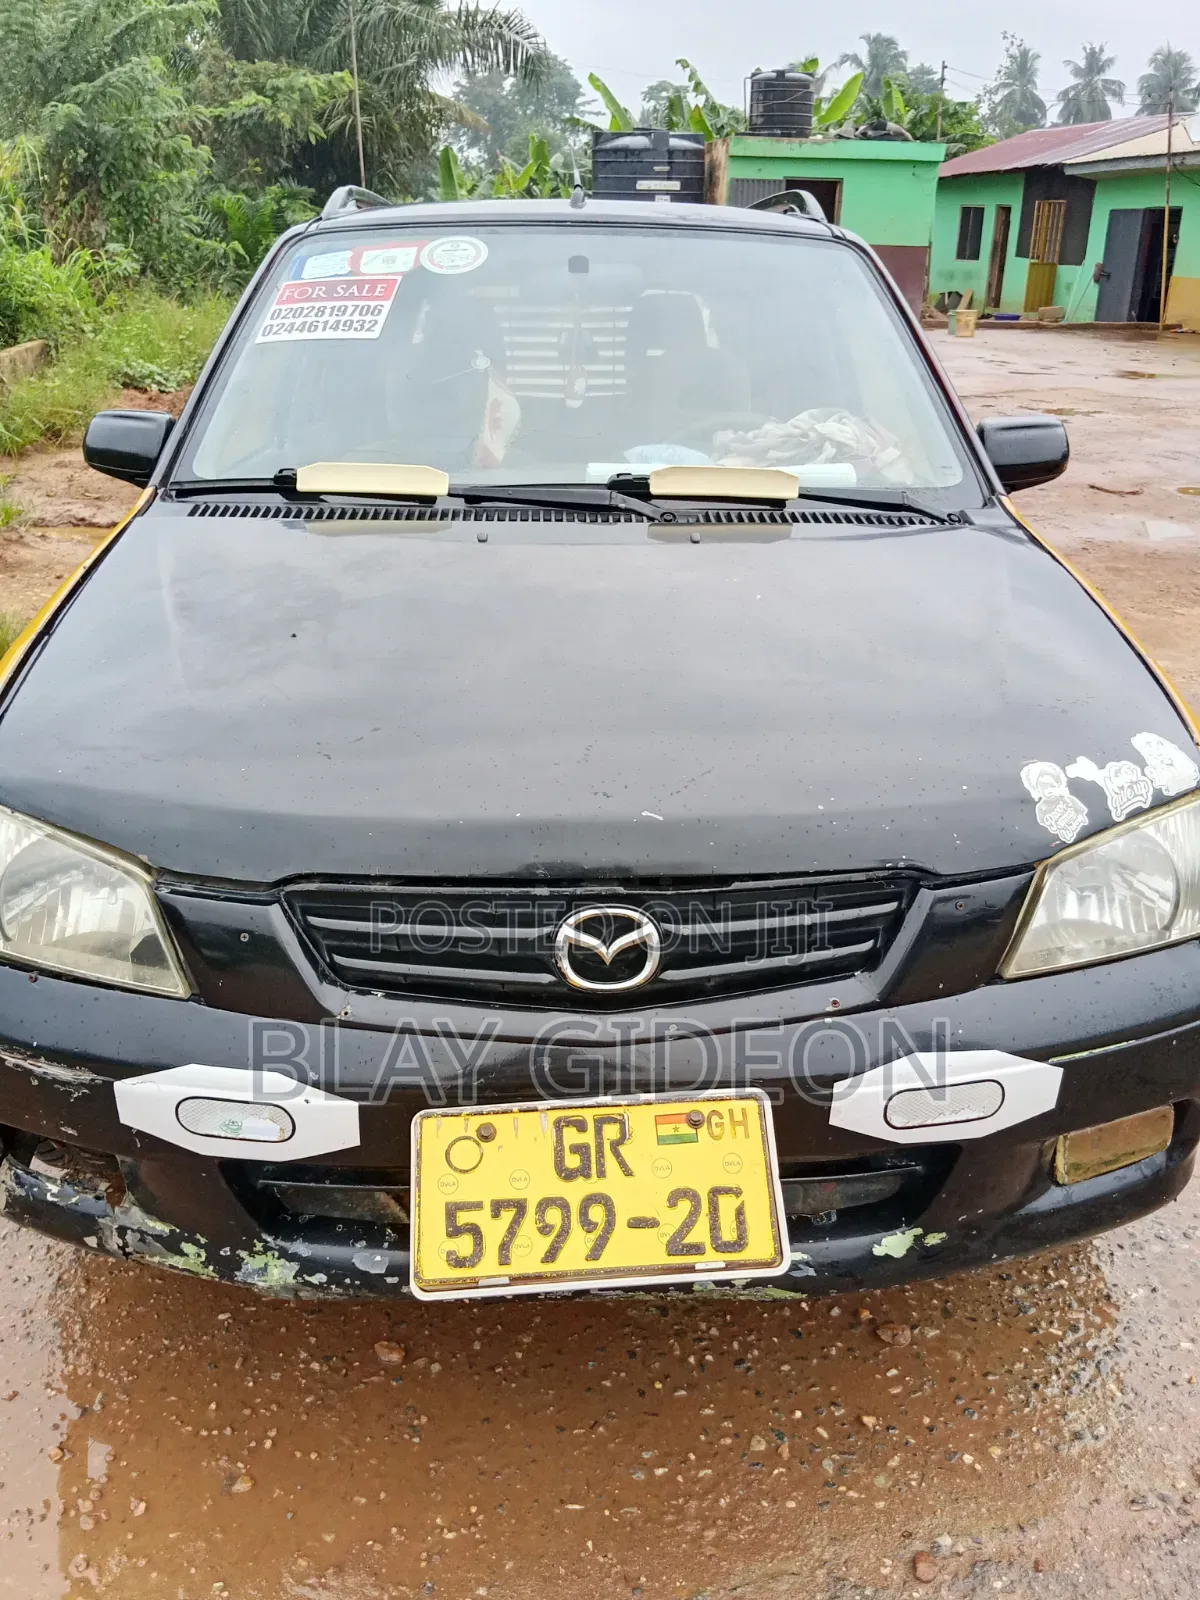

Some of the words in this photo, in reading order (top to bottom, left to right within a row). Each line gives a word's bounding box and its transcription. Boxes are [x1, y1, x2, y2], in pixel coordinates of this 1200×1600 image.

[281, 286, 327, 302] FOR
[333, 283, 388, 298] SALE
[270, 304, 383, 321] 0202819706
[261, 319, 377, 336] 0244614932
[706, 1108, 749, 1141] GH
[553, 1113, 635, 1183] GR
[724, 1160, 741, 1168] DVLA
[440, 1180, 456, 1188] DVLA
[444, 1185, 749, 1270] 5799-20
